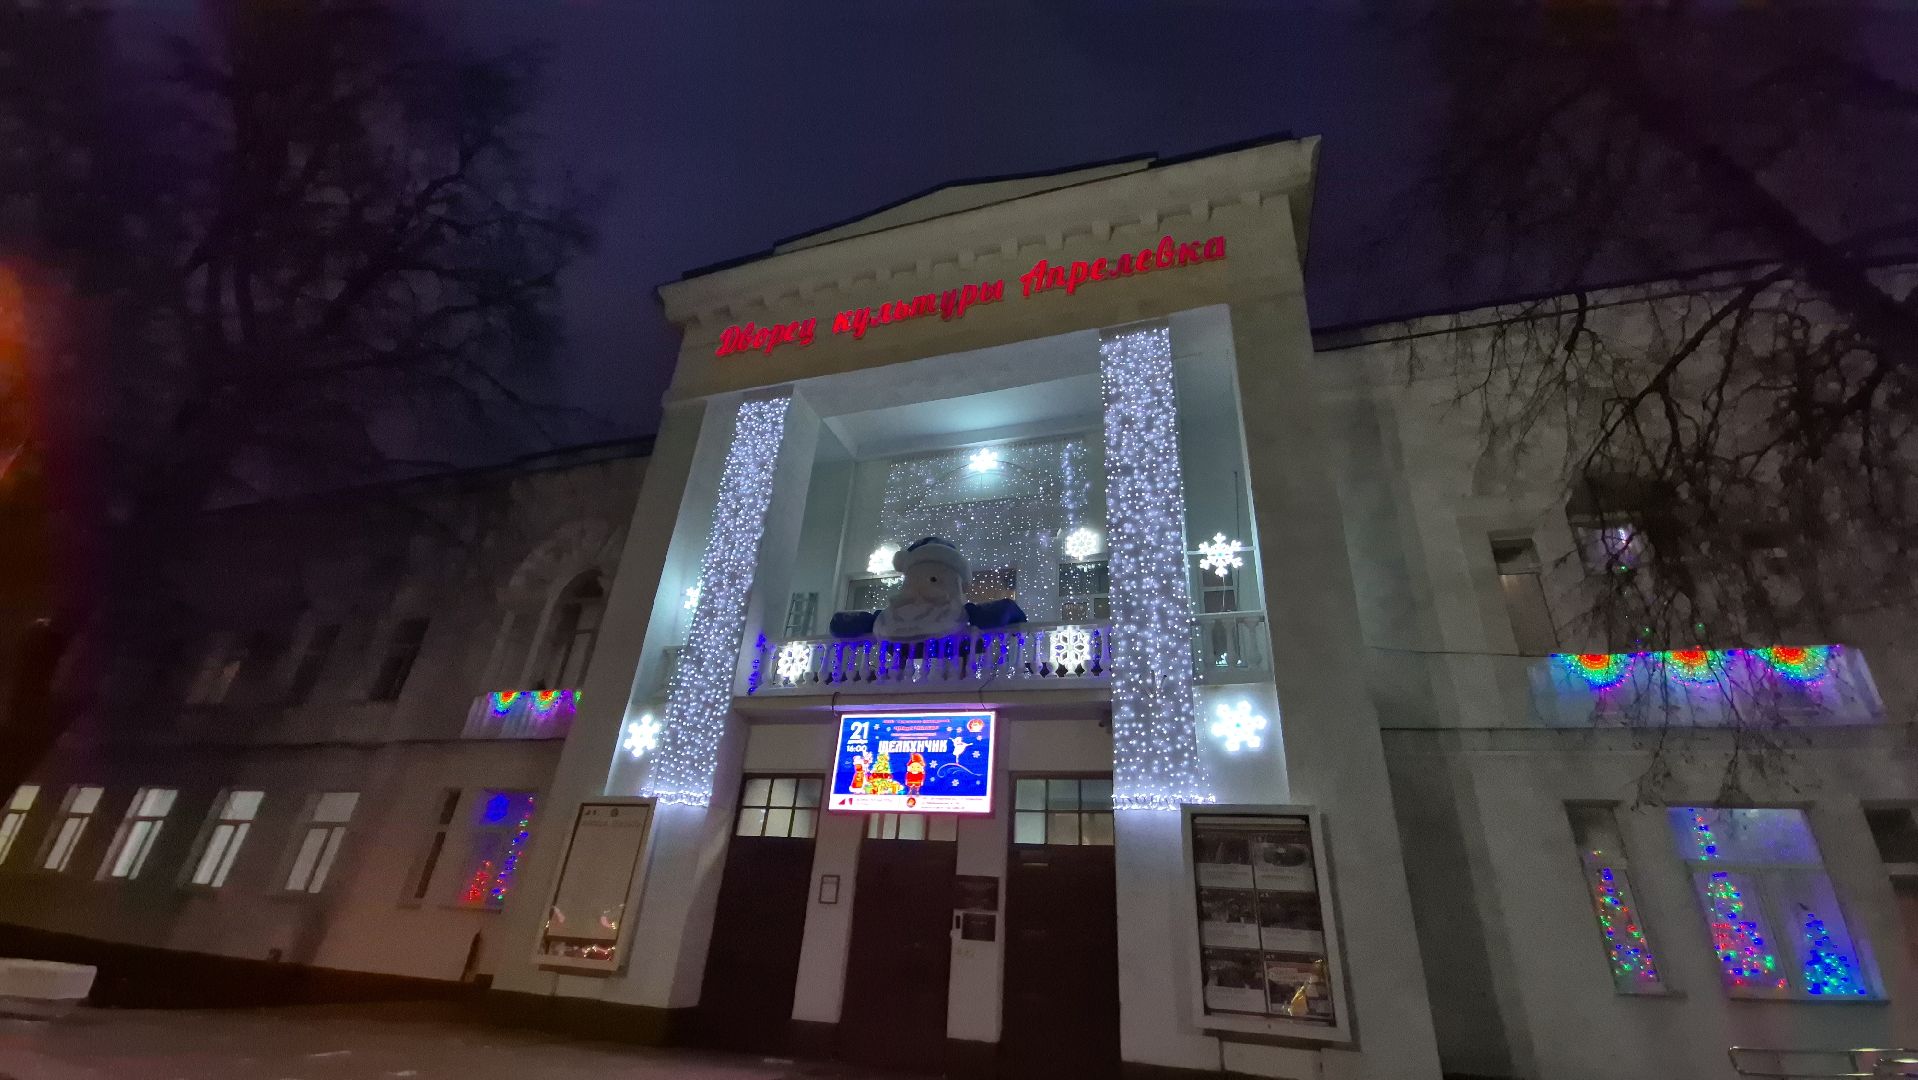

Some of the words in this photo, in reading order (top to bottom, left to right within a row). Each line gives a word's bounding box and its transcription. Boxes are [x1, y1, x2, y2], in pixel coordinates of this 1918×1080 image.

[715, 317, 817, 356] Дворец
[832, 278, 1006, 339] культуры
[1019, 234, 1227, 298] Апрелевка
[849, 721, 870, 740] 21
[846, 744, 868, 753] 16:00
